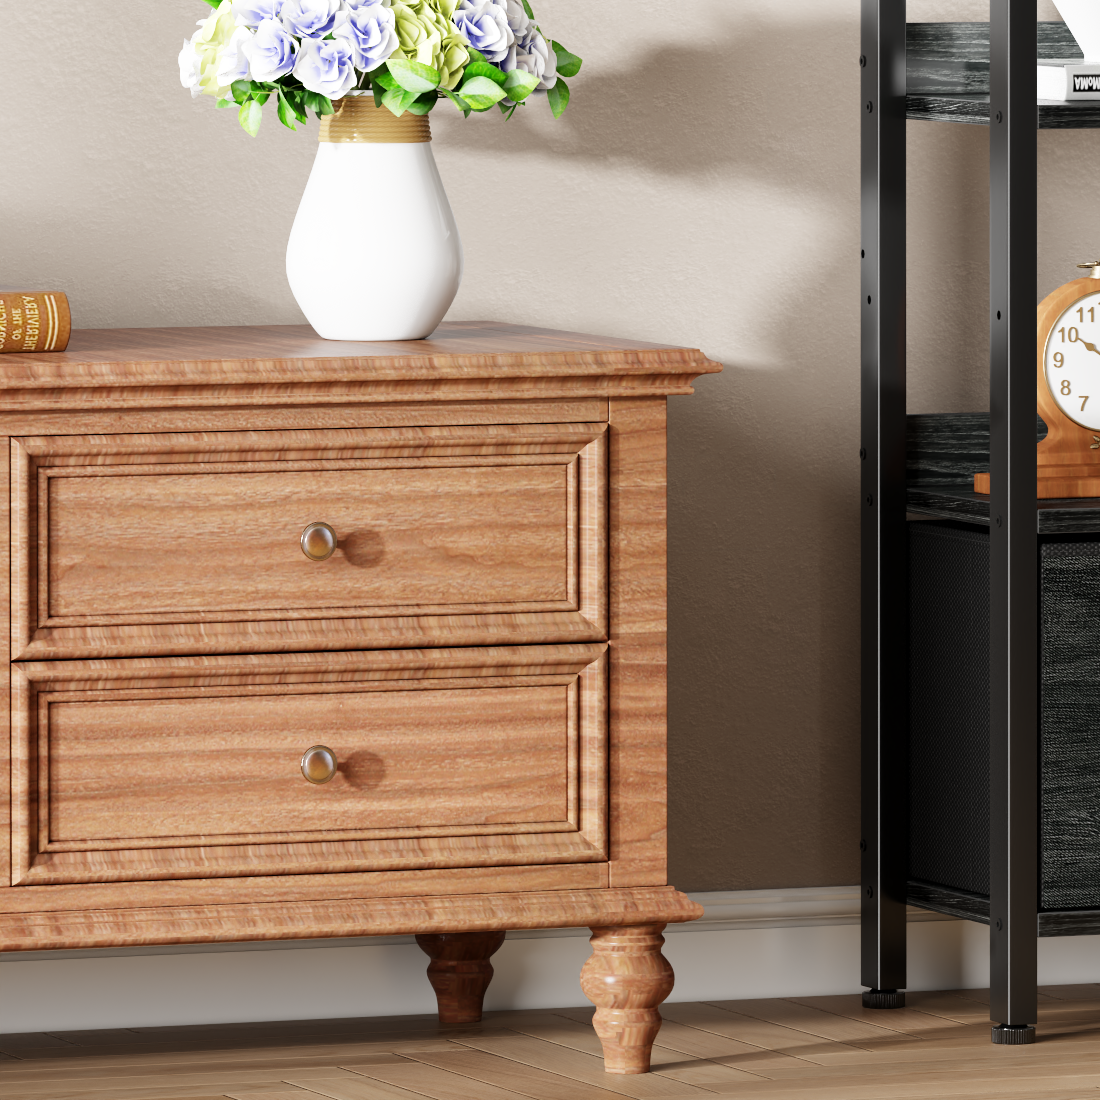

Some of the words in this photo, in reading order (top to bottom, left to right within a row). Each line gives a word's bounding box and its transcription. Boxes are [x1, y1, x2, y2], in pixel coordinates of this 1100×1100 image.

[1074, 76, 1100, 90] MoMA
[1076, 306, 1095, 323] 11
[1057, 326, 1079, 343] 10
[1053, 351, 1064, 368] 9
[1060, 379, 1071, 396] 8
[1078, 395, 1089, 412] 7
